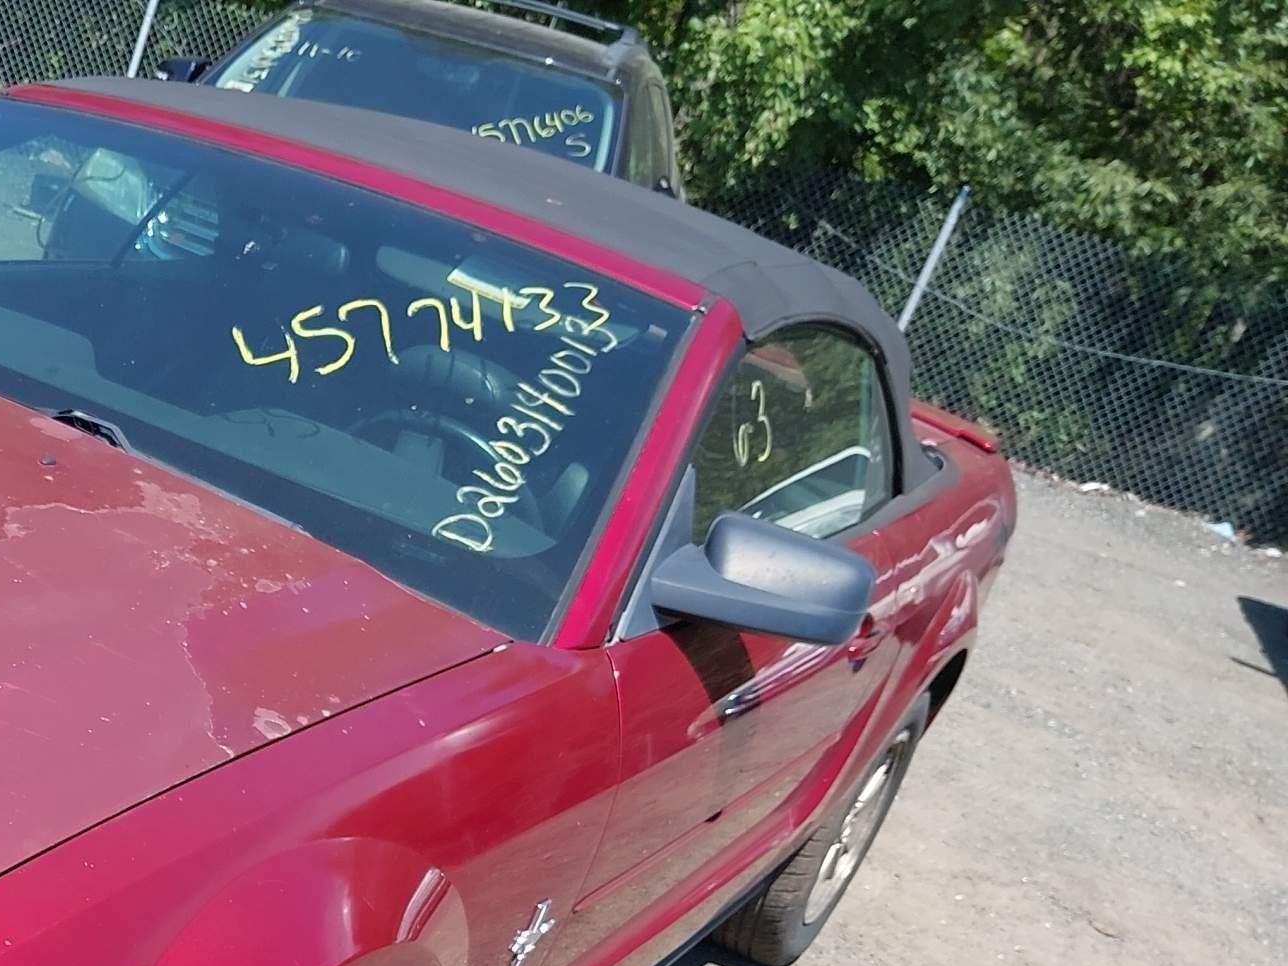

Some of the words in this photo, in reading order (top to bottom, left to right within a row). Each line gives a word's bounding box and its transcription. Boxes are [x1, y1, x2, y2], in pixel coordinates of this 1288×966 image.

[472, 104, 594, 144] 5776406
[231, 282, 610, 383] 45774133
[432, 315, 618, 553] D2603140013
